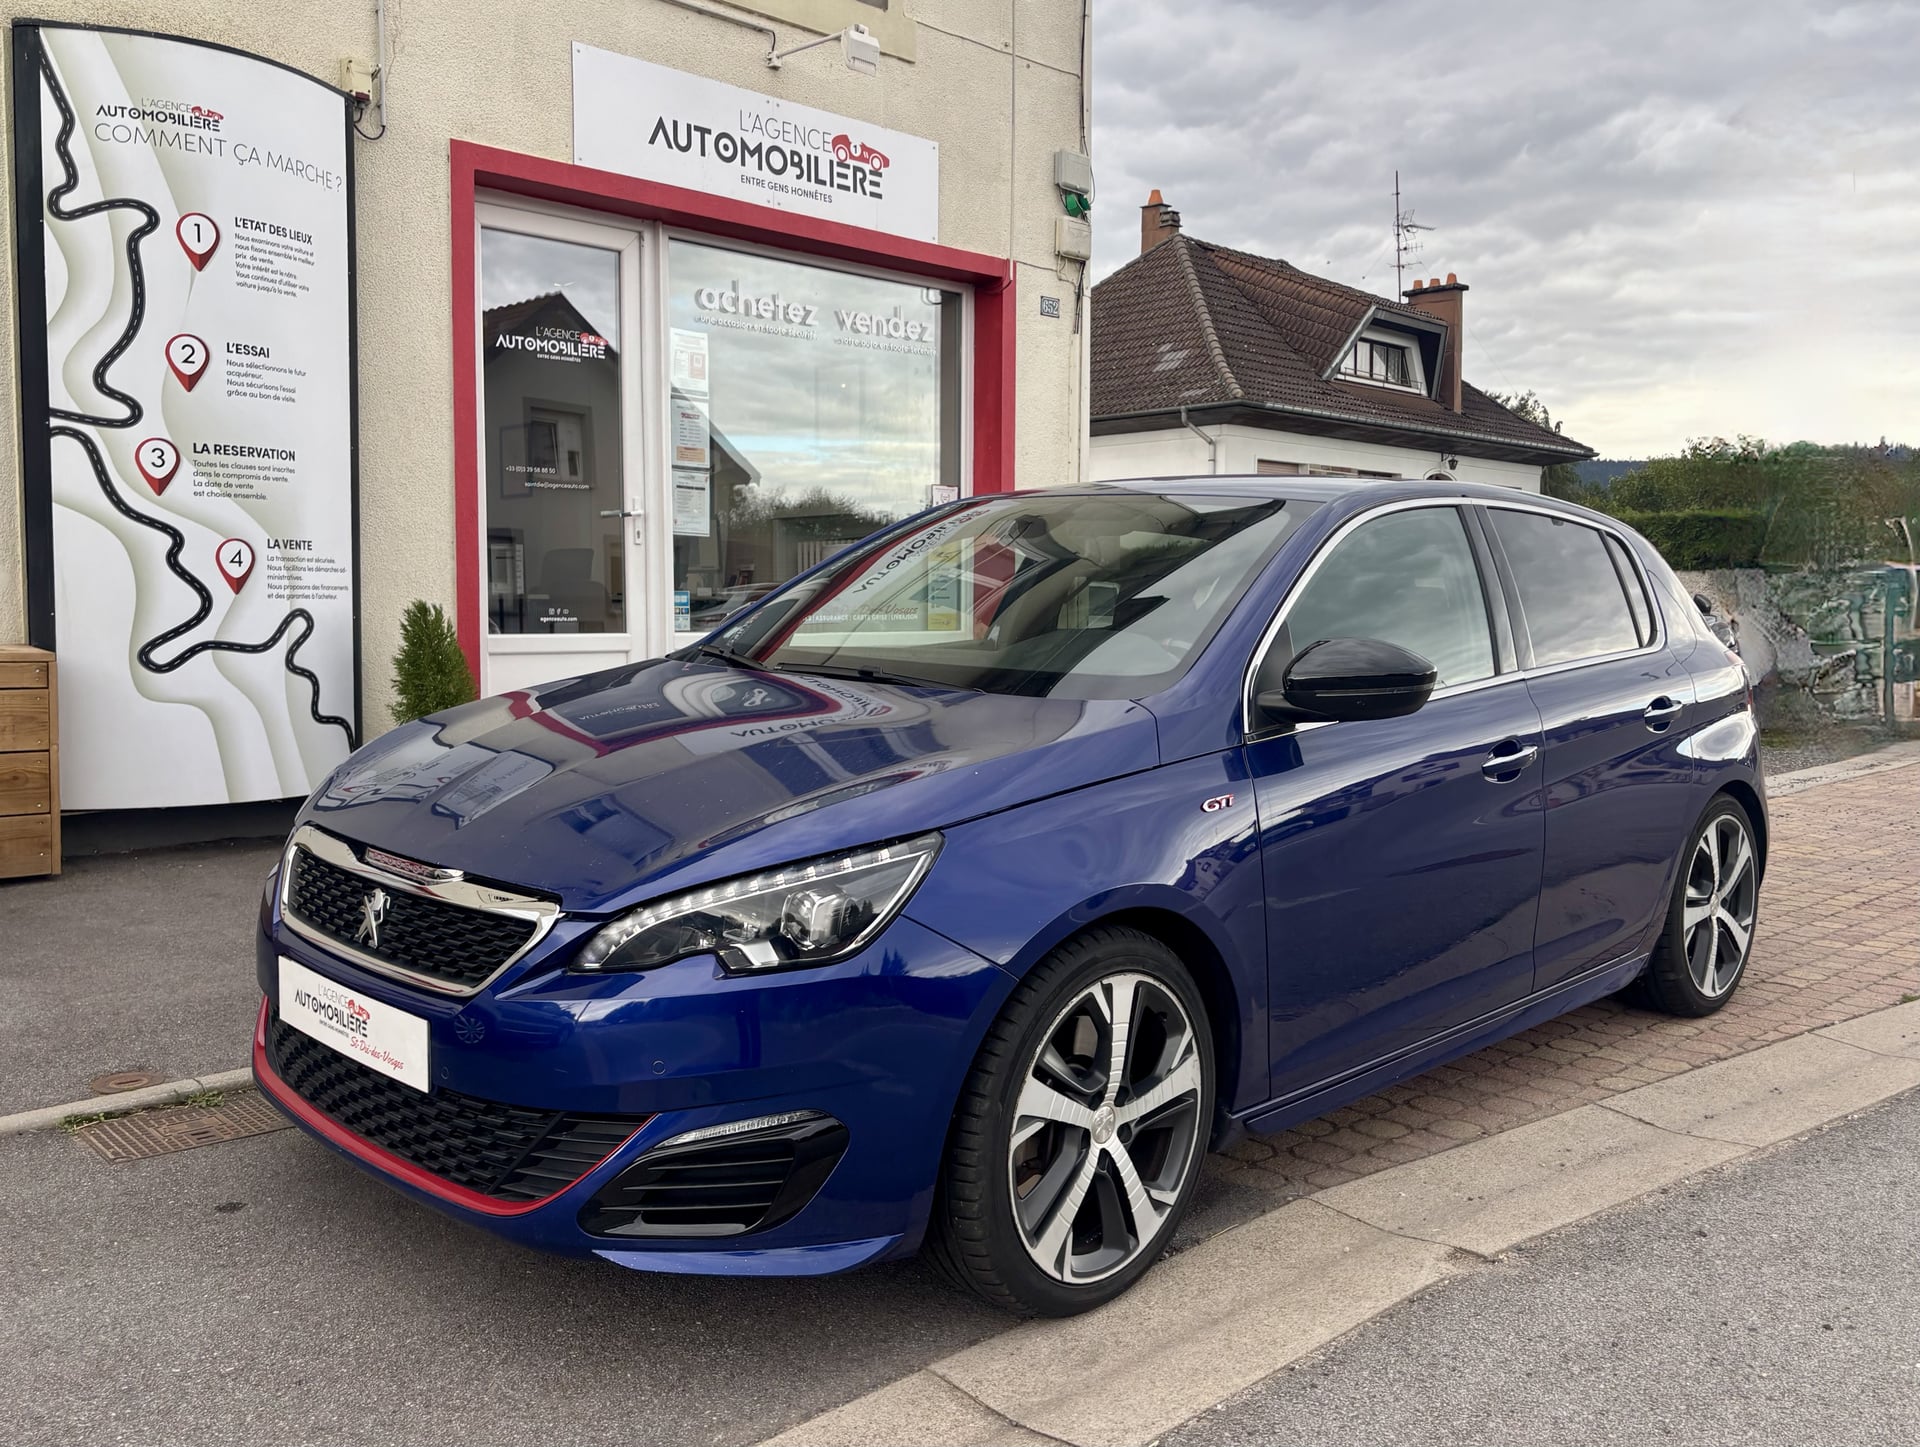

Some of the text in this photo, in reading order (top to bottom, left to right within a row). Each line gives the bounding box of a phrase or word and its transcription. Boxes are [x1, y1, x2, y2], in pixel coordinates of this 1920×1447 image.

[141, 97, 192, 113] L'AGENCE
[96, 105, 220, 132] AUTOMOBILIERE
[739, 109, 832, 153] L'AGENCE
[95, 122, 342, 192] COMMENT ÇA MARCHE ?
[648, 116, 882, 200] AUTOMOBILIERE
[740, 175, 833, 203] ENTRE GENS HONNÊTES
[193, 223, 201, 243] 1
[235, 217, 312, 245] L'ETAT DES LIEUX
[235, 233, 250, 242] Nous
[235, 261, 251, 270] Votre
[236, 270, 250, 279] Vous
[236, 281, 256, 289] voiture
[696, 279, 819, 326] achetez
[836, 304, 936, 342] vendez
[535, 326, 580, 341] L'AGENCE
[181, 344, 196, 364] 2
[226, 342, 270, 359] L'ESSAI
[495, 334, 606, 359] AUTOMOBILIERE
[226, 359, 244, 368] Nous
[226, 379, 245, 387] Nous
[246, 381, 279, 391] sécurisons
[226, 389, 247, 397] grâce
[259, 392, 271, 400] bon
[151, 448, 166, 468] 3
[193, 442, 296, 462] LA RESERVATION
[193, 460, 218, 469] Toutes
[219, 461, 229, 469] les
[231, 462, 256, 471] clauses
[193, 470, 212, 478] dans
[222, 472, 261, 481] compromis
[204, 480, 222, 488] date
[223, 481, 233, 489] de
[206, 490, 232, 498] choisie
[267, 538, 313, 551] LA VENTE
[229, 548, 243, 567] 4
[267, 564, 282, 572] Nous
[295, 989, 368, 1038] AUTOMOBILIERE
